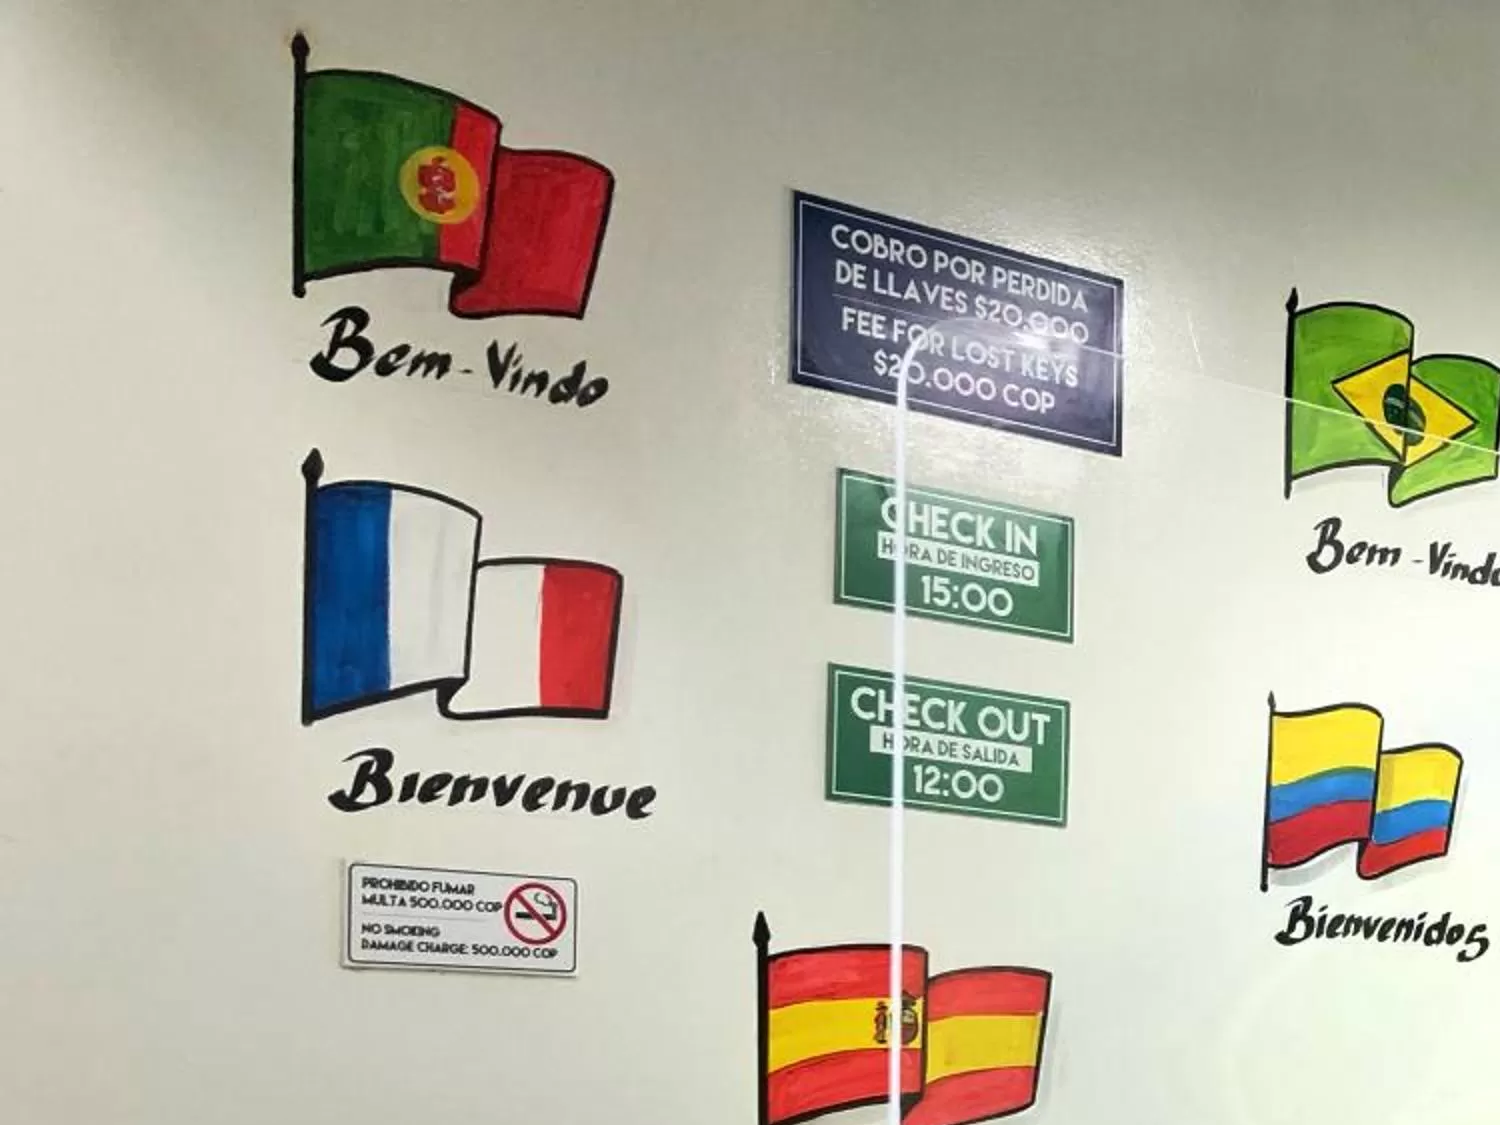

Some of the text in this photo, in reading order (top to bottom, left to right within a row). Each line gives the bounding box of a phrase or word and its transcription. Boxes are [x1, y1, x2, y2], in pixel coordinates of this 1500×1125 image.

[831, 224, 1088, 313] COBRO POR PERDIDA
[835, 260, 1088, 344] DE LLAVES $20.000
[842, 307, 1078, 387] FEE FOR LOST KEYS
[873, 349, 1055, 414] $20.000 COP
[881, 497, 1037, 555] CHECK IN
[882, 537, 1035, 581] HRA DE INGRESO
[921, 575, 1013, 617] 15:00
[850, 686, 1051, 745] CHECK OUT
[938, 739, 960, 758] DE
[962, 744, 1019, 767] SALIDA
[327, 748, 657, 820] Bienvenue
[912, 764, 1004, 802] 12:00
[361, 876, 476, 897] PROHIBIDO FUMAR
[361, 893, 502, 912] MULTA 500.000 COP
[361, 923, 441, 937] NO SMOKING
[361, 938, 414, 952] DAMAGE
[471, 944, 530, 958] 500.000
[533, 946, 558, 959] COP
[1274, 896, 1490, 962] Bienvenidos
